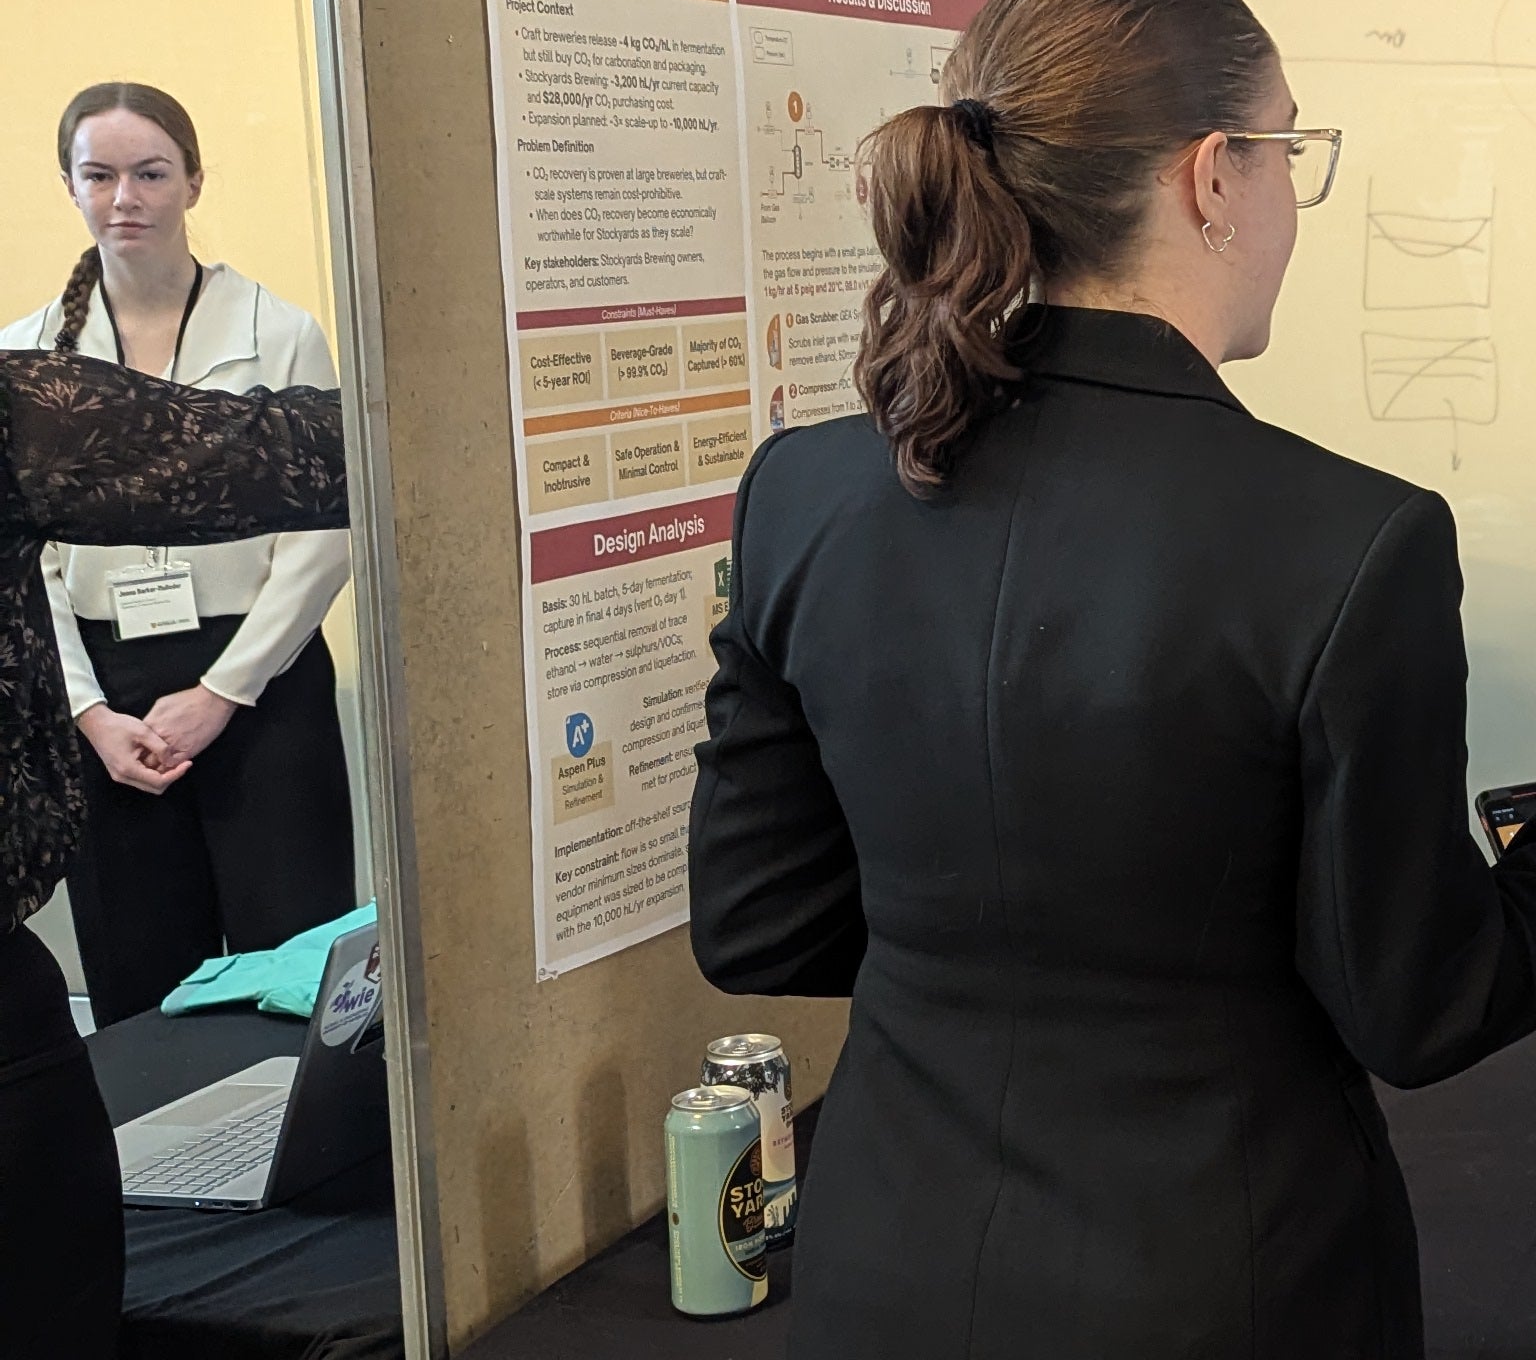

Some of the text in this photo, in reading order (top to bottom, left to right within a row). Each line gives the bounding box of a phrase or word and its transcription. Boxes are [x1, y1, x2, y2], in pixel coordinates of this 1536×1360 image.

[536, 0, 574, 16] Context
[521, 26, 726, 56] Craft breweries release fermentation
[522, 48, 652, 70] but still buy carbonation
[524, 68, 720, 95] Stockyards hL/yr current capacity
[527, 92, 655, 112] and $28,000/yr purchasing
[528, 110, 659, 131] Expansion scale-up
[517, 139, 595, 154] Problem Definition
[549, 168, 695, 183] recovery proven large breweries,
[534, 188, 622, 203] scale systems remain
[536, 205, 717, 222] When does recovery become economically
[537, 225, 694, 243] worthwhile Stockyards they scale?
[524, 252, 676, 273] Key stakeholders: Stockyards Brewing
[775, 247, 823, 262] process begins
[525, 274, 630, 293] operators, and customers.
[601, 306, 637, 321] Constraints
[610, 344, 673, 361] Beverage-Grade
[689, 339, 718, 356] Majority
[530, 351, 592, 370] Cost-Effective
[687, 355, 721, 373] Captured
[542, 373, 572, 389] 5-year
[693, 429, 748, 449] Energy-Efficient
[614, 442, 672, 462] Safe Operation
[704, 449, 745, 467] Sustainable
[542, 456, 581, 476] Compact
[618, 460, 679, 482] Minimal Control
[543, 475, 591, 495] Inobtrusive
[593, 513, 705, 557] Design Analysis
[542, 579, 645, 614] Basis: batch, 5-day
[543, 602, 633, 634] capture final days
[544, 614, 688, 660] Process: sequential removal trace
[546, 653, 615, 681] ethanol water
[547, 660, 652, 700] store compression and
[642, 686, 684, 709] Simulation:
[629, 713, 656, 732] design
[622, 727, 671, 754] compression
[557, 755, 606, 781] Aspen Plus
[628, 752, 675, 777] Refinement:
[562, 777, 597, 796] Simulation
[564, 790, 604, 810] Refinement
[554, 806, 672, 859] Implementation: off-the-shelf
[555, 829, 680, 884] Key constraint: flow small
[555, 862, 648, 903] vendor minimum sizes
[556, 880, 645, 924] equipment was sized
[556, 899, 646, 943] with the 10,000 hL/yr
[730, 1178, 763, 1203] STO
[731, 1197, 763, 1218] YAR
